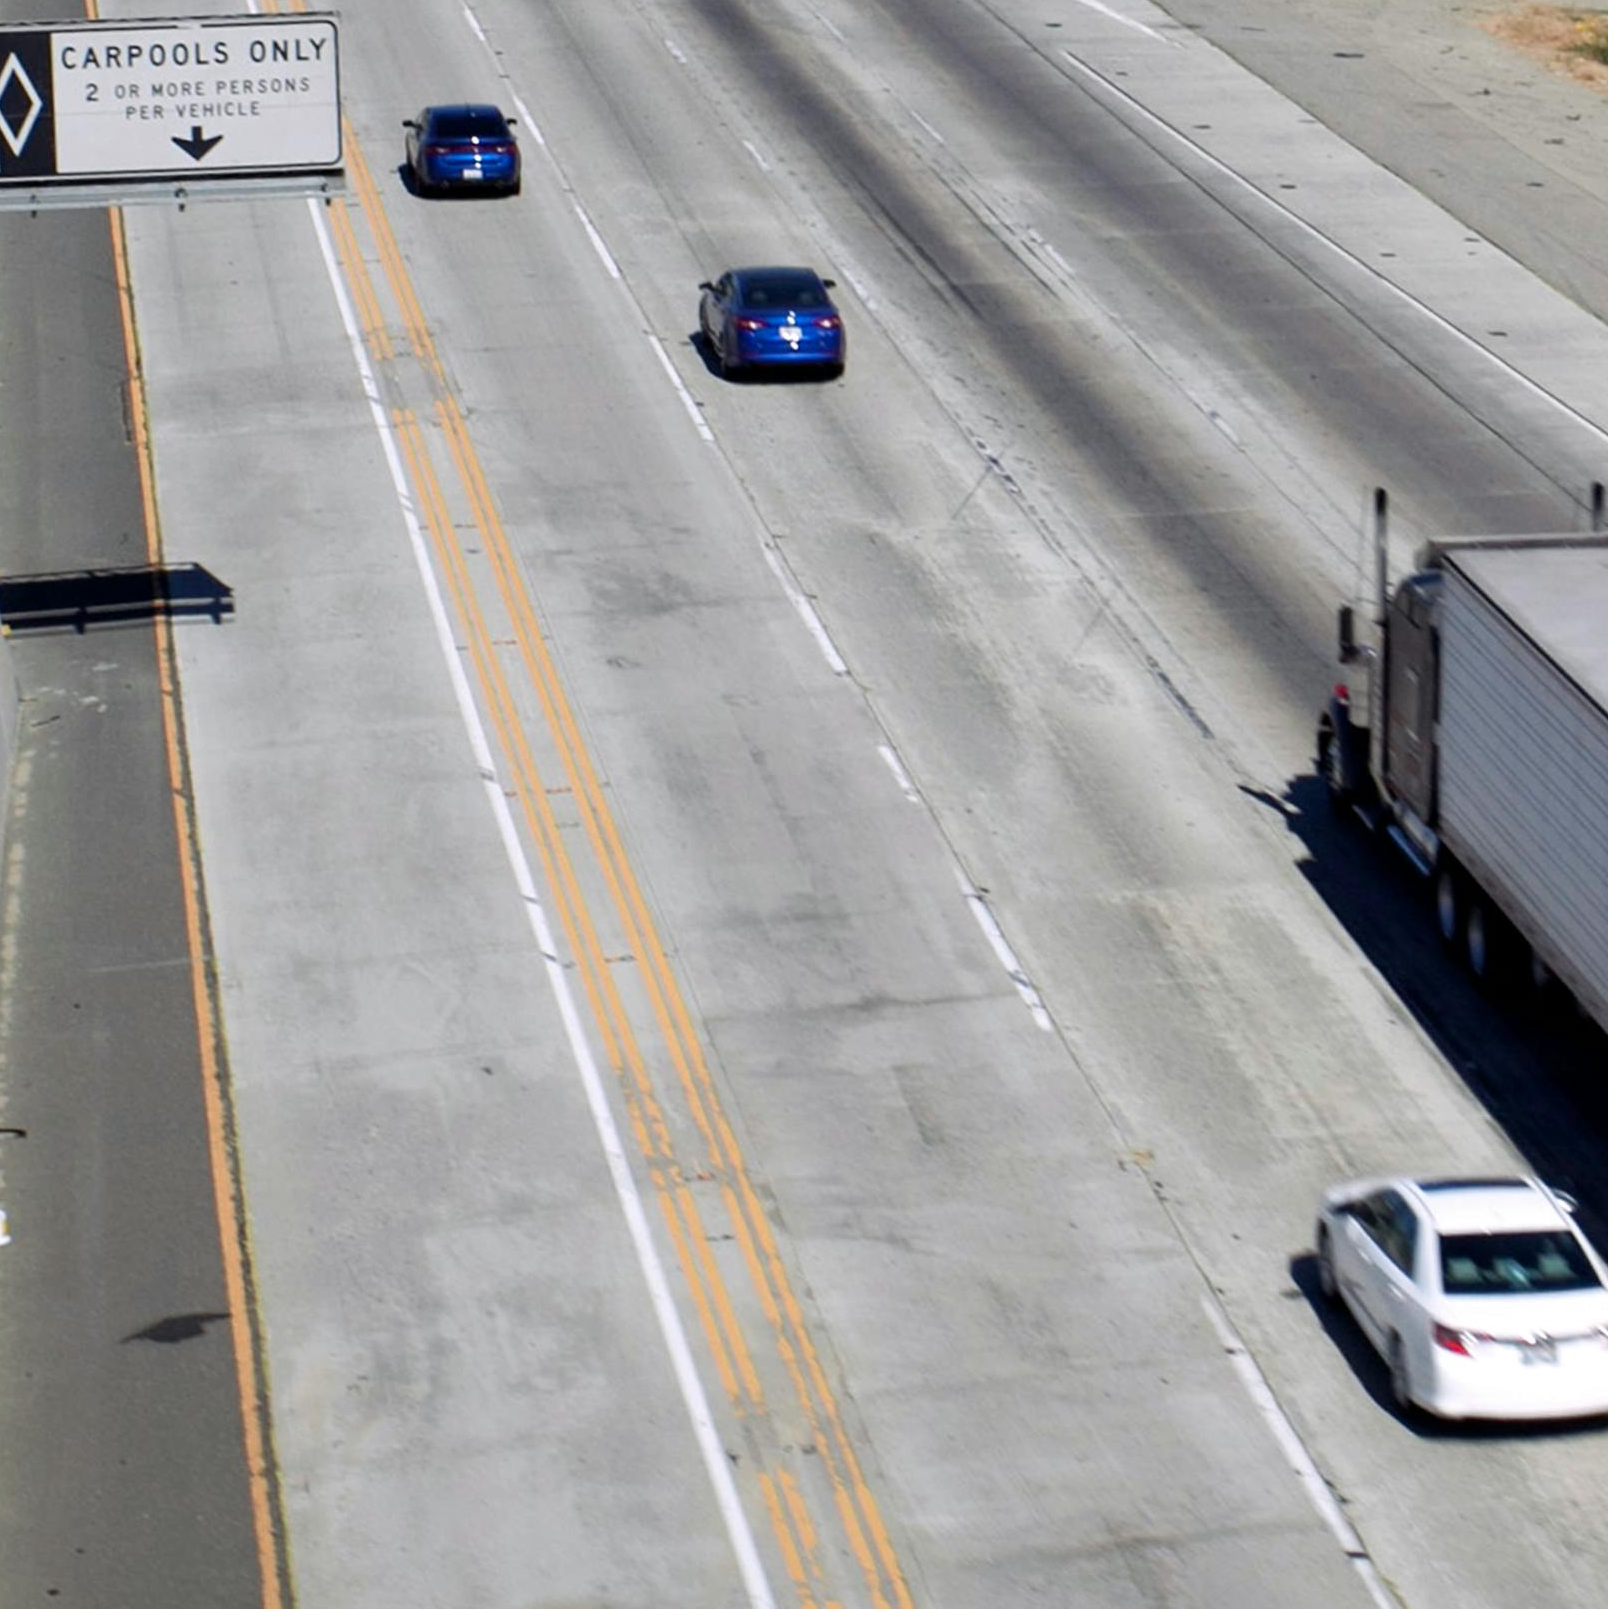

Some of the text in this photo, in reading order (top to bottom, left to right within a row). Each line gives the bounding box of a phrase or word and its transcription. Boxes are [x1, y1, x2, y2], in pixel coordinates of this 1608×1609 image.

[61, 38, 327, 70] CARPOOLS ONLY
[85, 77, 311, 102] 2 OR MORE PERSONS
[126, 101, 261, 120] PER VEHICLE
